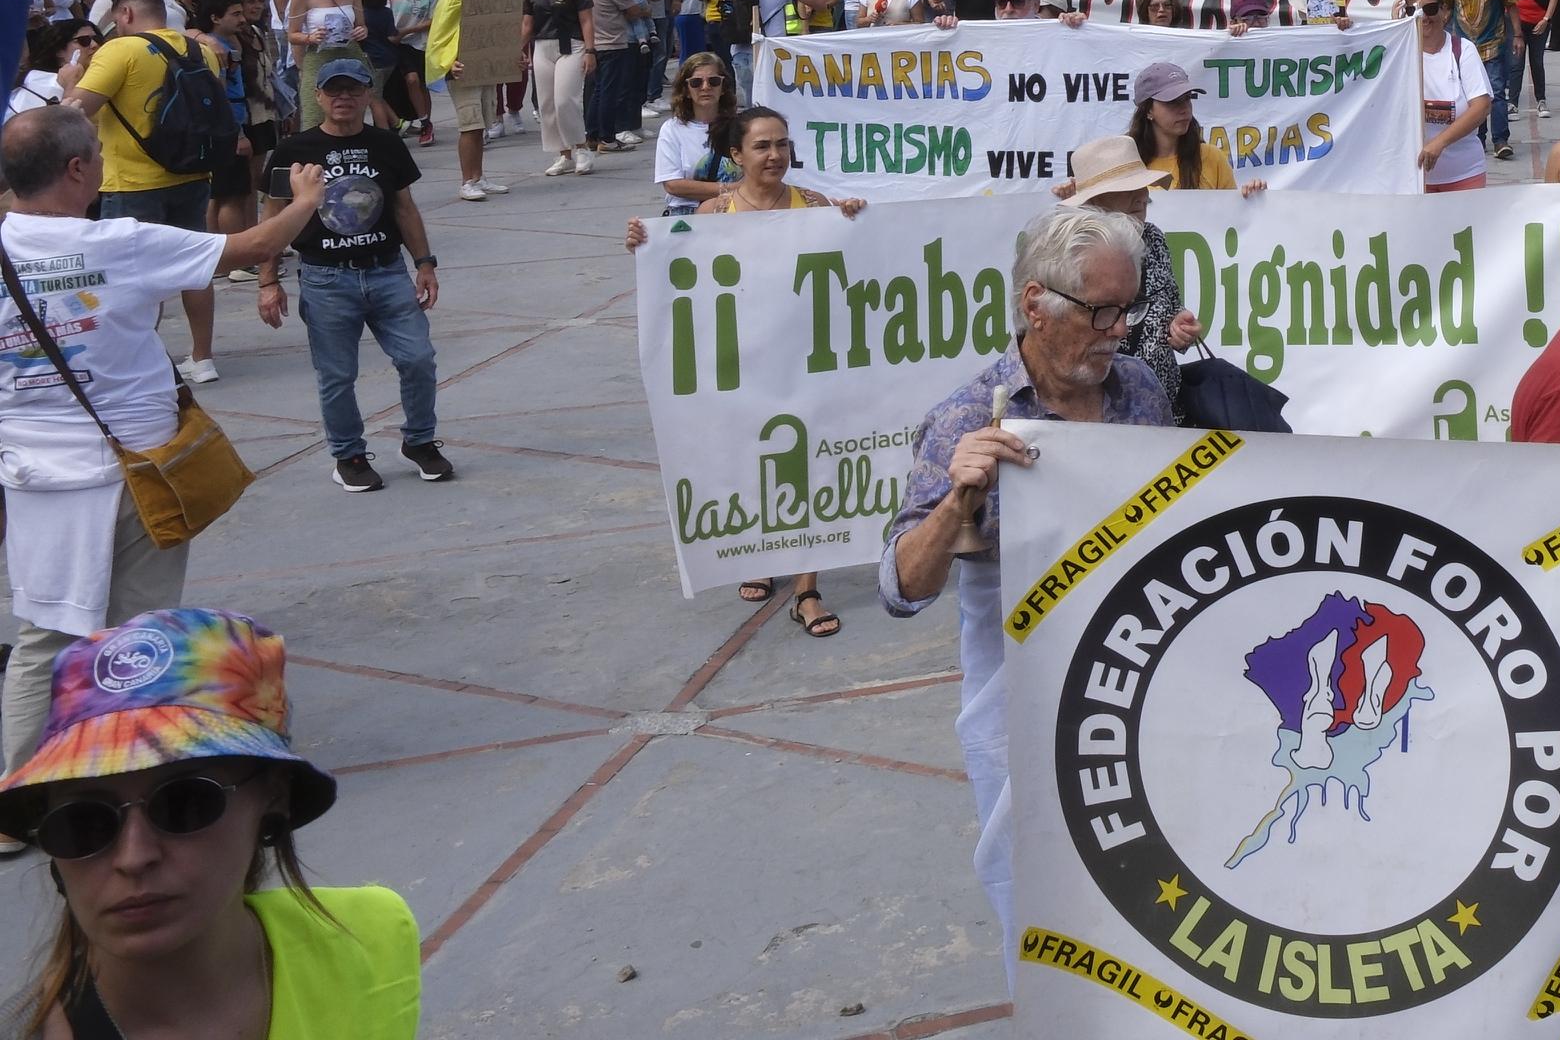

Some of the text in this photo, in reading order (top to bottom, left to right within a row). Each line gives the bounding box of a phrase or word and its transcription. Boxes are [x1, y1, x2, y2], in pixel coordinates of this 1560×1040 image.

[774, 45, 1387, 102] CANARIAS NO VIVE TURISMO
[323, 163, 380, 183] NO HAY
[806, 121, 972, 176] TURISMO
[987, 150, 1054, 178] VIVE
[34, 262, 46, 272] SE
[50, 258, 83, 271] AGOTA
[322, 231, 387, 250] PLANETA B
[40, 272, 106, 293] TURÍSTICA
[1164, 226, 1479, 386] Dignidad
[717, 530, 851, 559] www.laskellys.org
[1026, 430, 1242, 615] FRAGIL FRAGIL
[1078, 509, 1364, 852] FEDERACIÓN
[1386, 533, 1548, 700] FORO
[1037, 935, 1143, 1001] FRAGIL
[1168, 895, 1472, 1005] LA ISLETA
